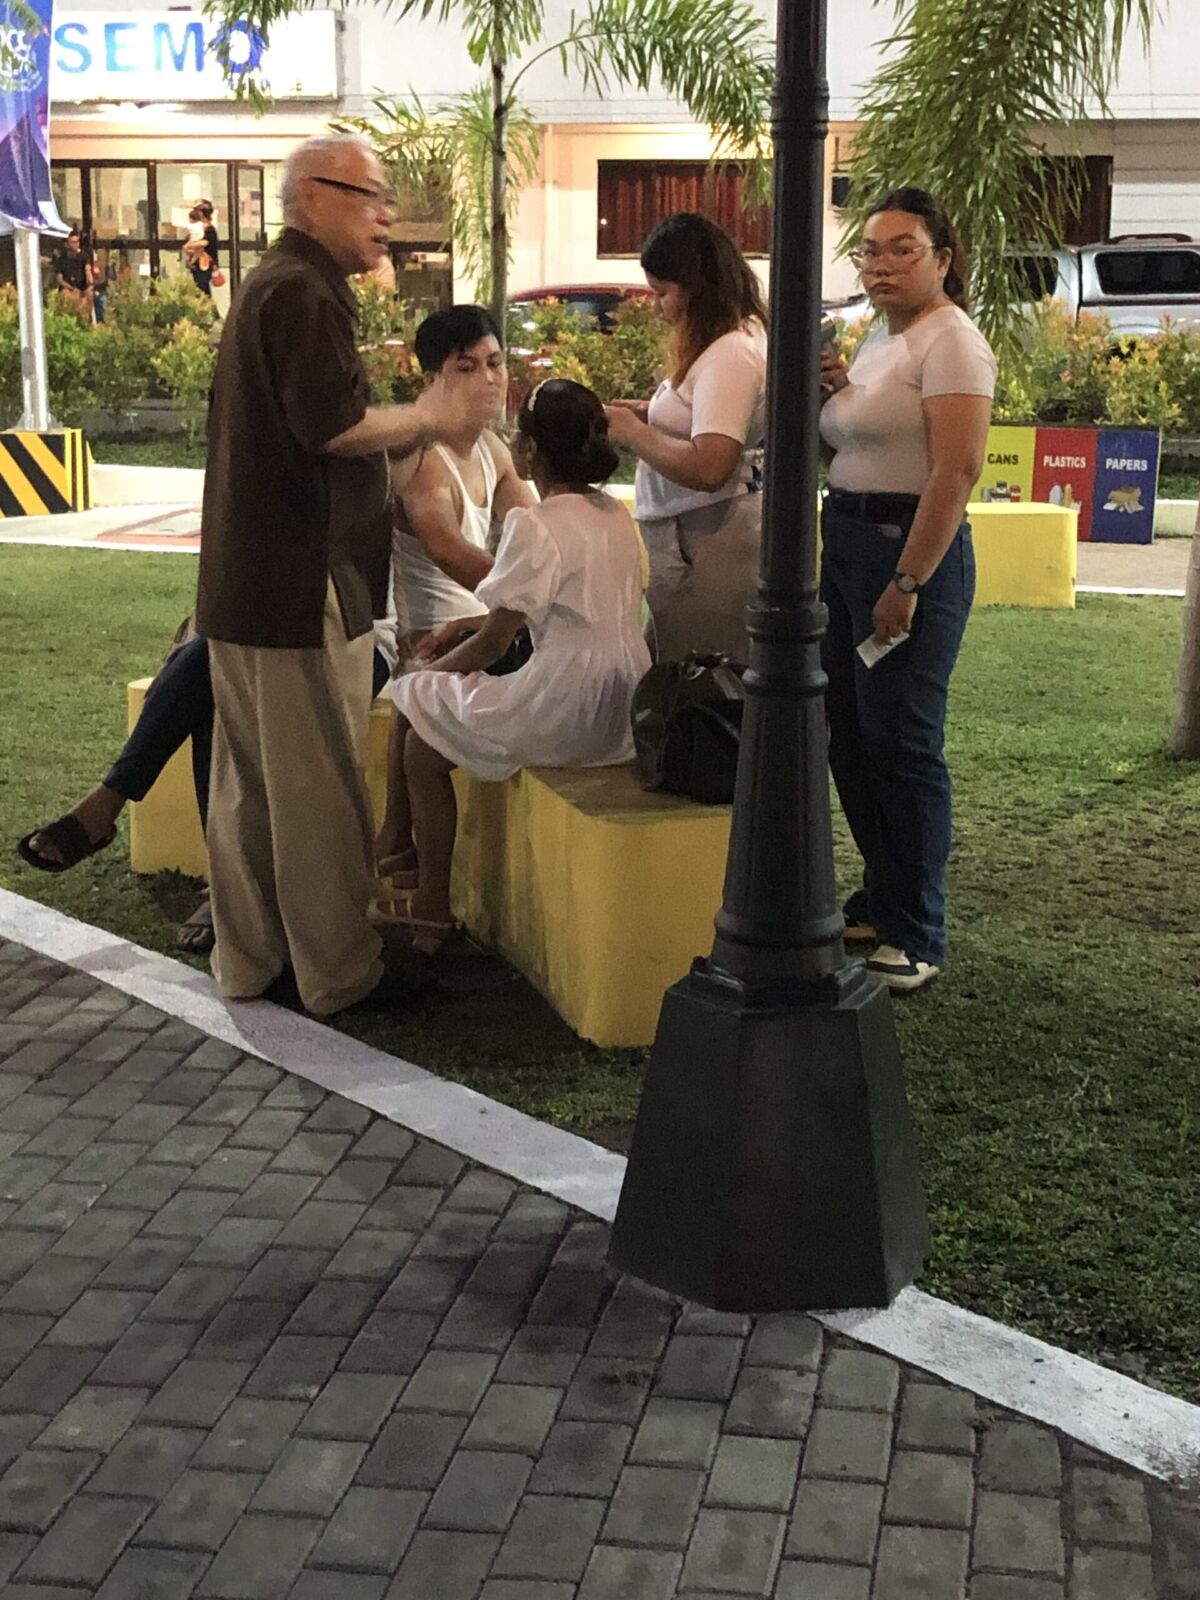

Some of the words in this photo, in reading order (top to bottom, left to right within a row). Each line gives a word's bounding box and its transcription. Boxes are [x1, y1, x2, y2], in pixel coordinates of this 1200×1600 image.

[987, 453, 1019, 465] CANS
[1043, 455, 1086, 469] PLASTICS
[1105, 458, 1148, 471] PAPERS
